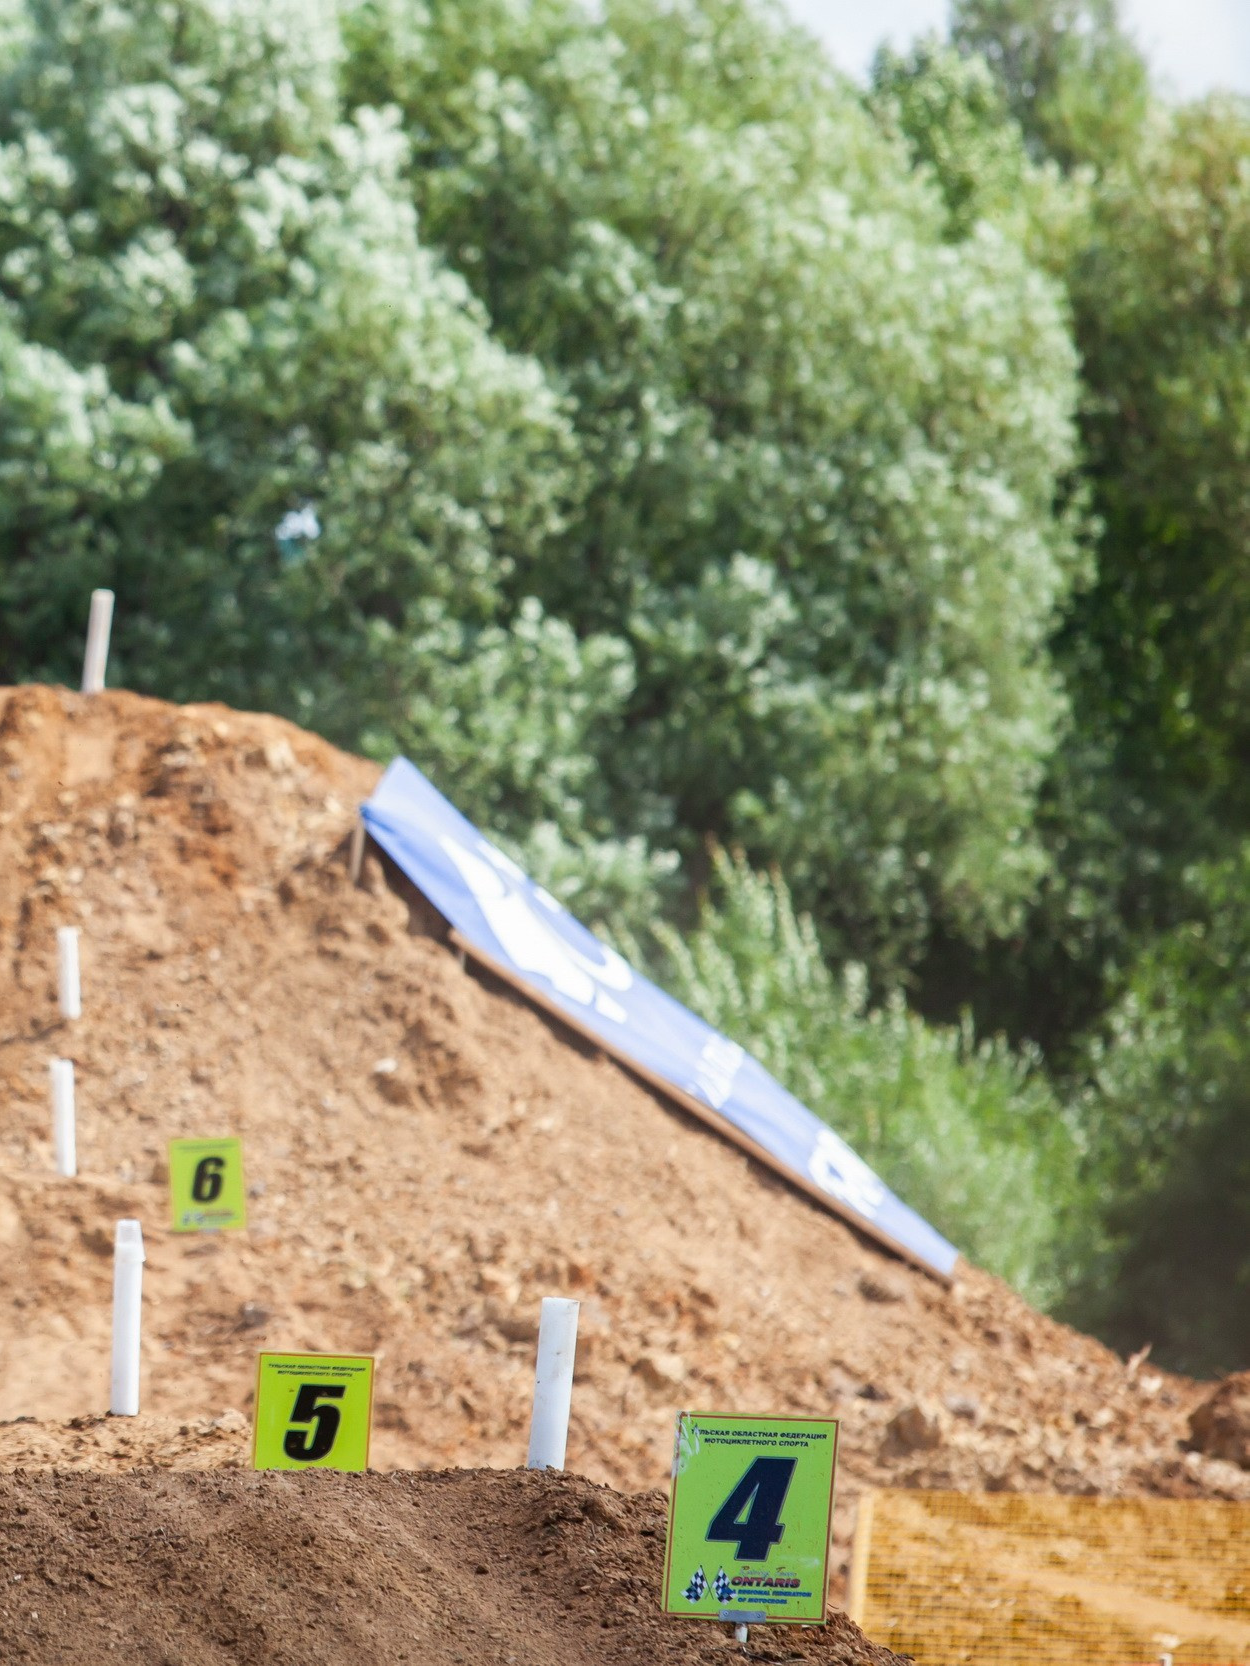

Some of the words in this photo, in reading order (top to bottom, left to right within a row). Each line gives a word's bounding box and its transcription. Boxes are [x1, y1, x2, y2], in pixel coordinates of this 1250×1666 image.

[192, 1155, 226, 1204] 6
[283, 1383, 347, 1462] 5
[691, 1428, 730, 1436] ТЛЬСКАЯ
[732, 1430, 778, 1438] ОБЛАСТНАЯ
[704, 1438, 777, 1447] МОТОЦИКЛЕТНОГО
[705, 1455, 798, 1562] 4
[731, 1576, 801, 1588] ONTARIS
